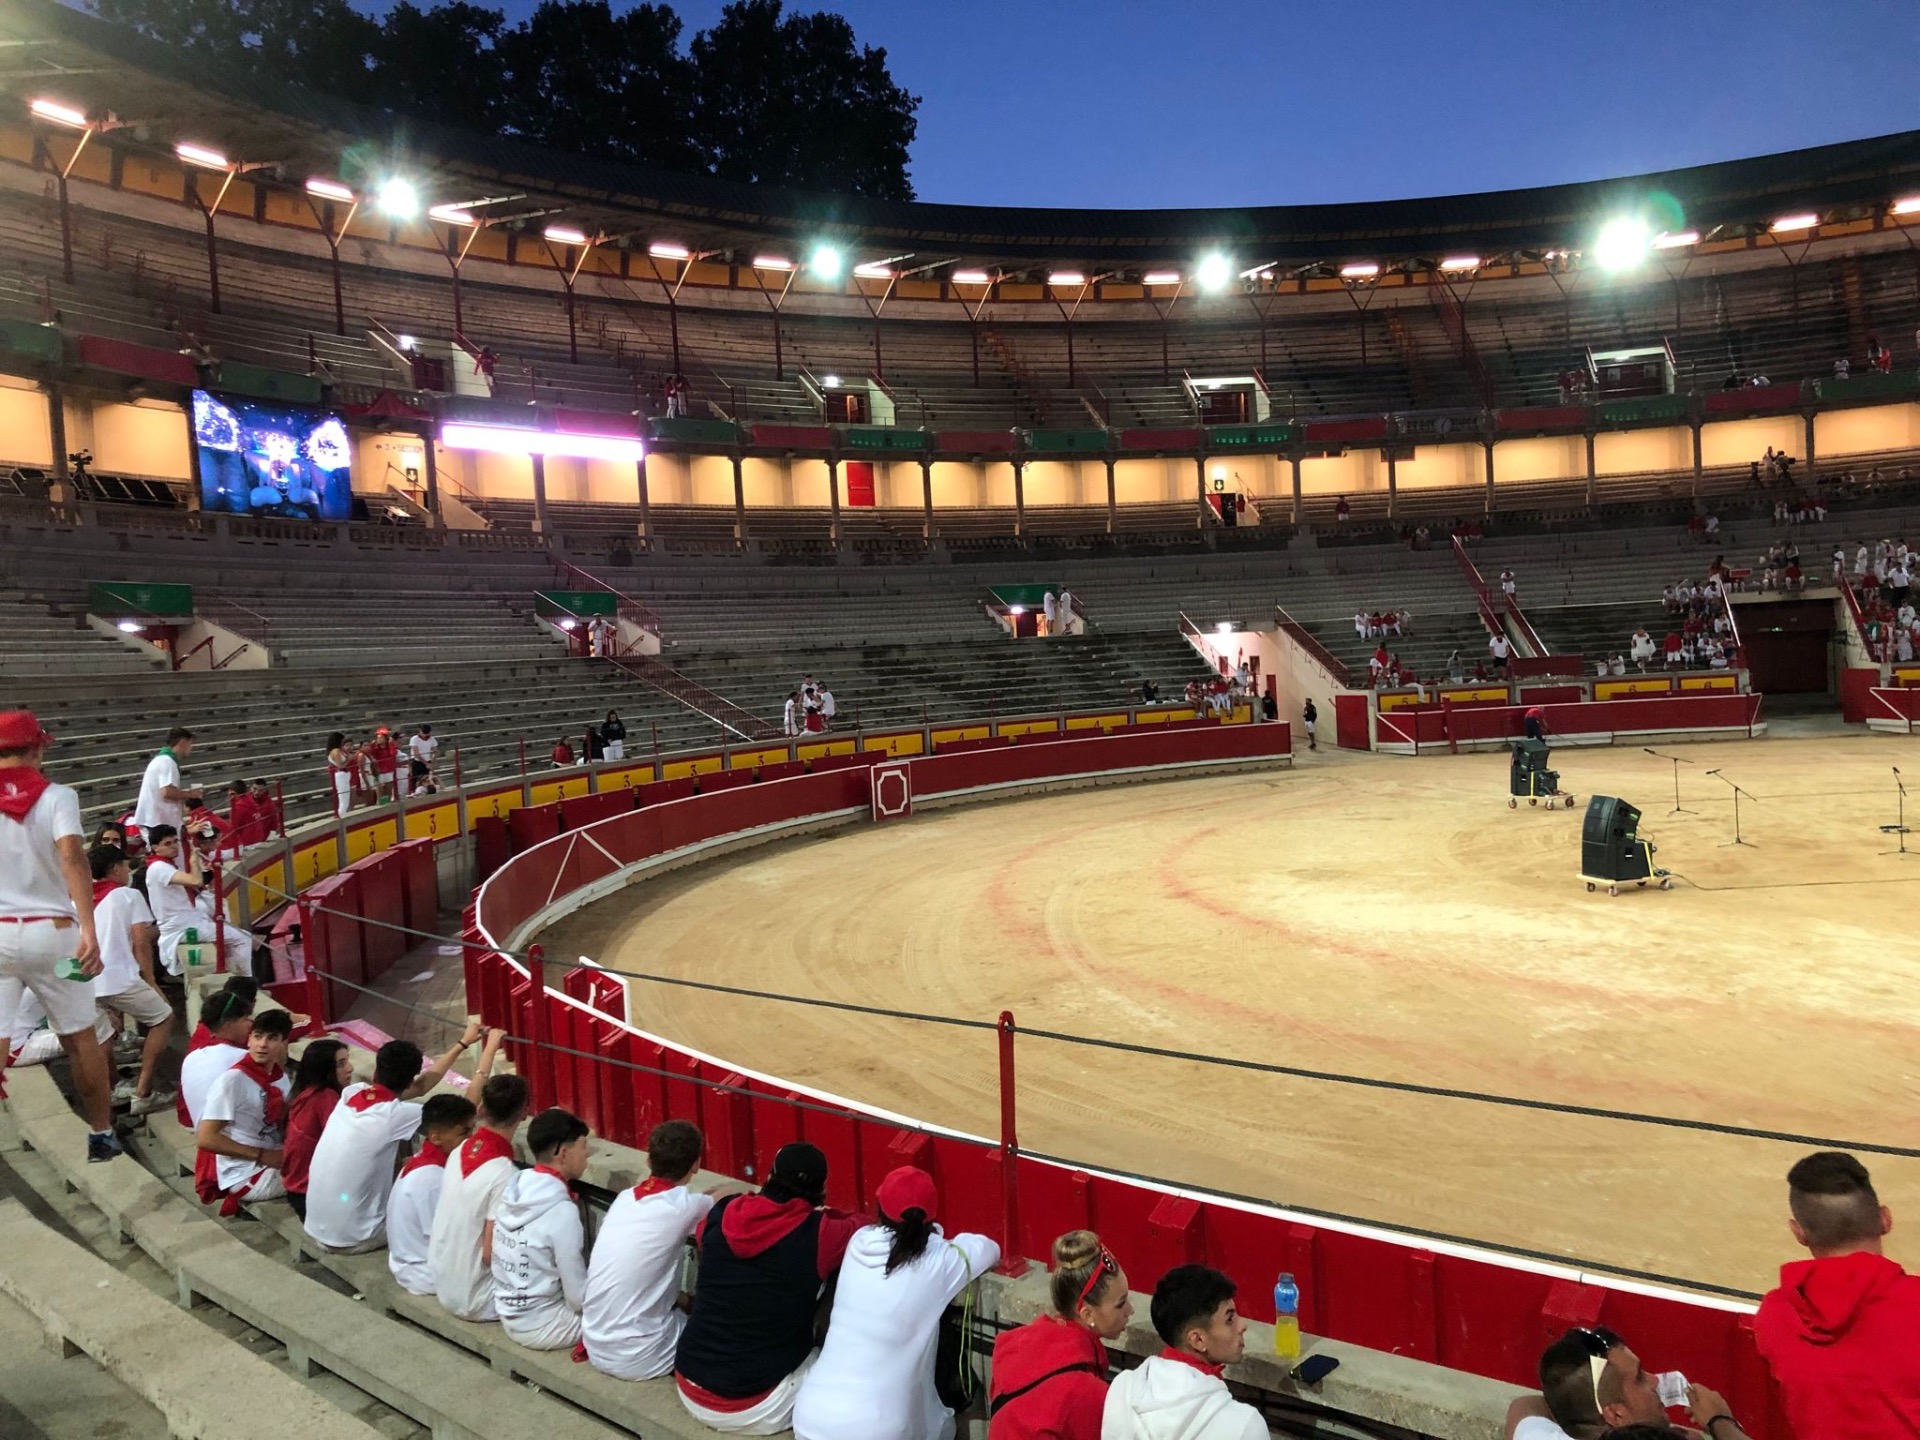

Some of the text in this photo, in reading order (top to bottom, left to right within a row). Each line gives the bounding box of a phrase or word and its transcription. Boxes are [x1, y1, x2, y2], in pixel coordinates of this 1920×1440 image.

[824, 746, 831, 757] 4
[889, 739, 898, 752] 4
[757, 755, 765, 766] 3
[690, 764, 698, 776] 3
[623, 774, 631, 788] 3
[558, 785, 566, 800] 3
[492, 798, 500, 818] 3
[429, 813, 437, 835] 3
[368, 831, 377, 854] 3
[312, 852, 320, 878] 3
